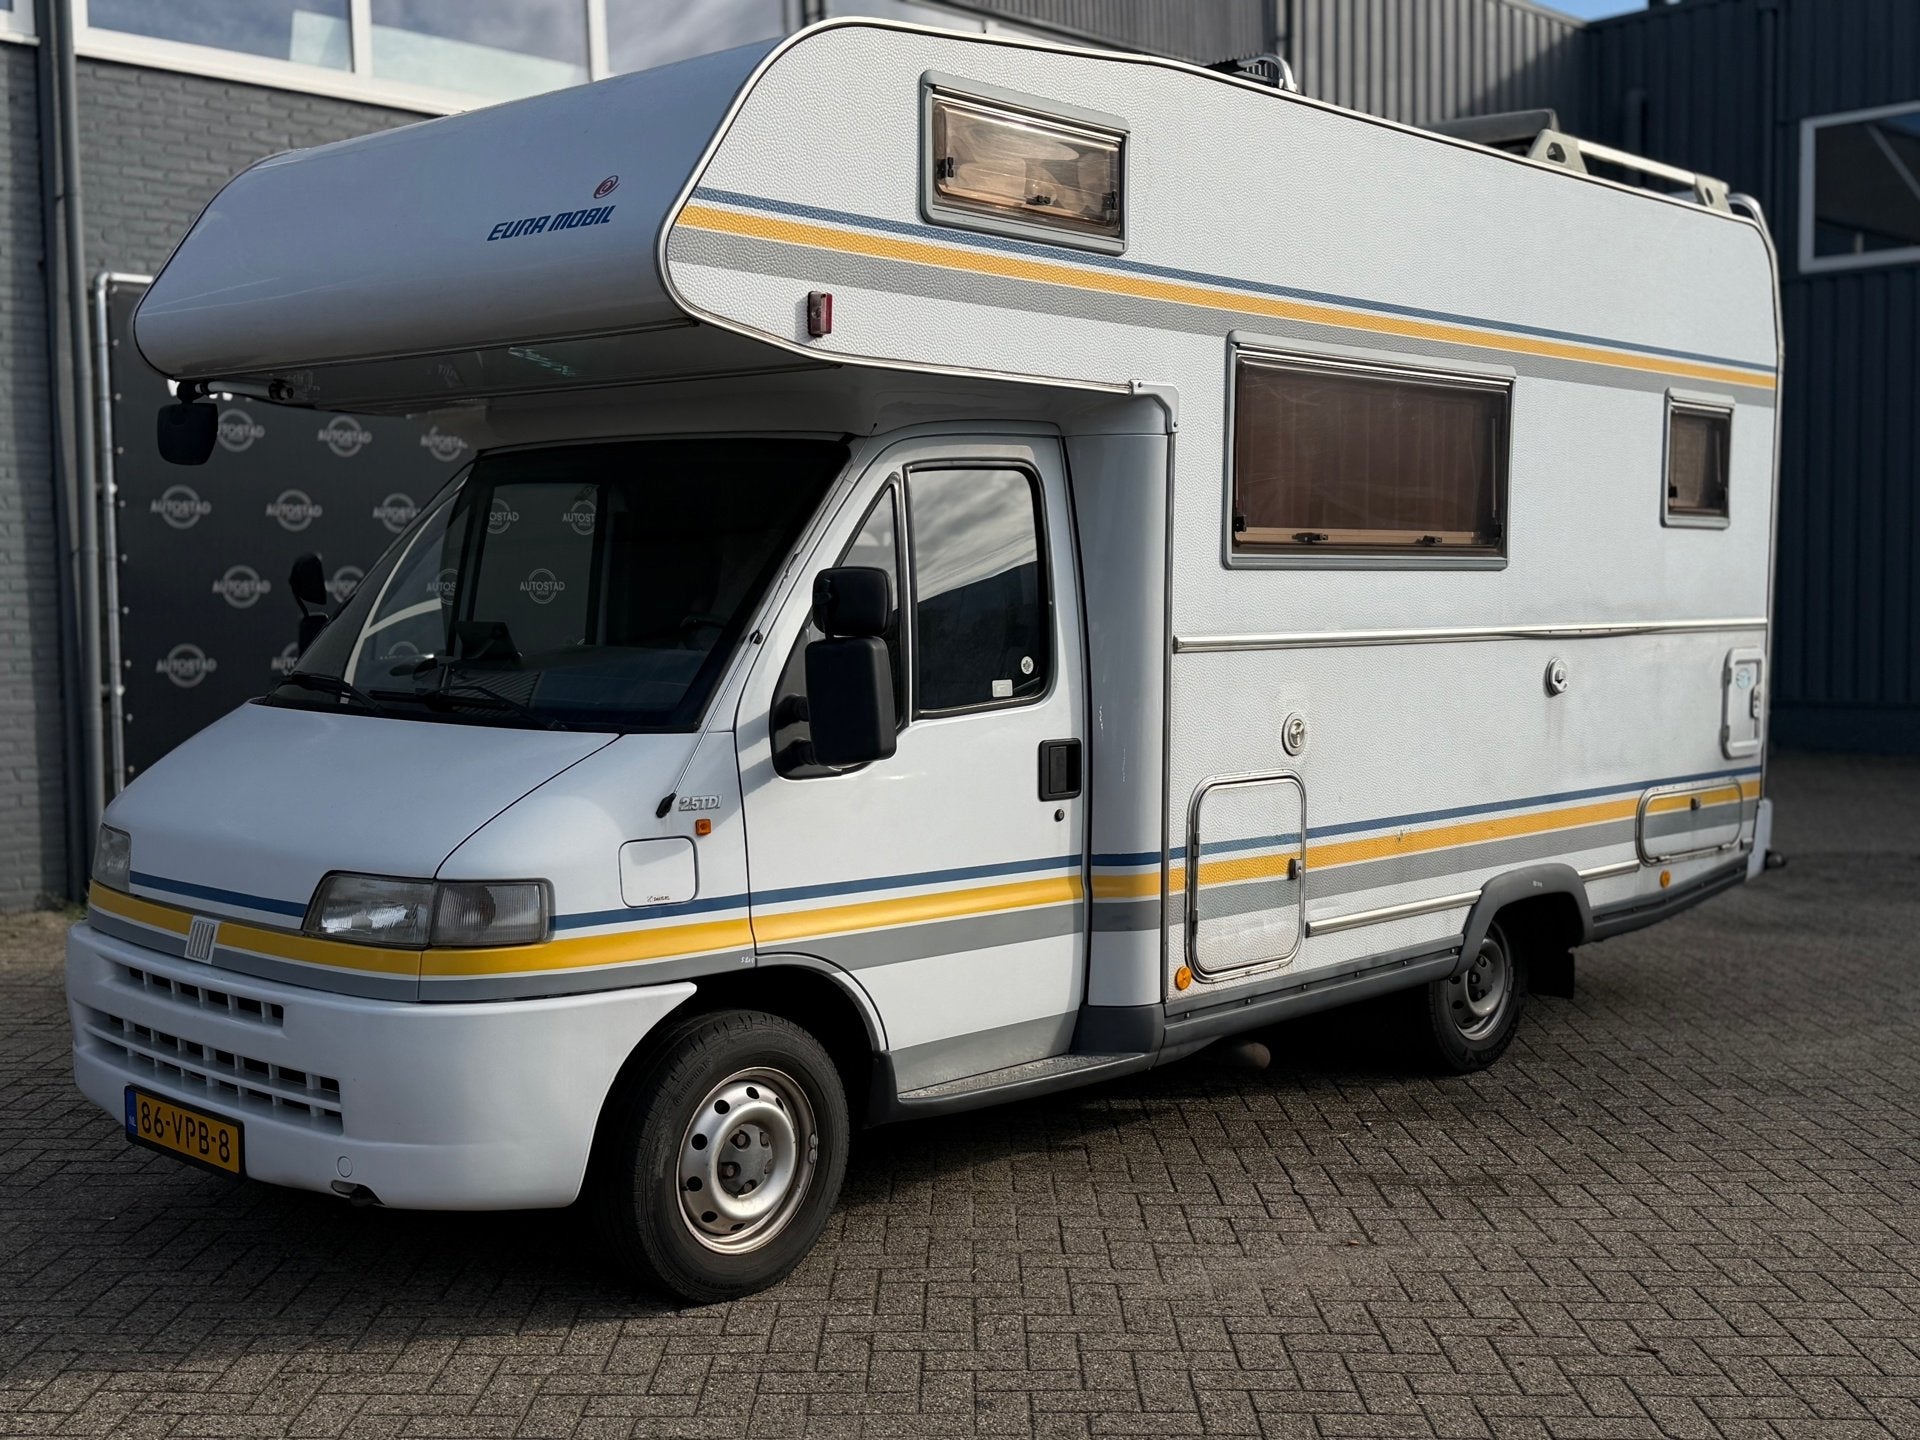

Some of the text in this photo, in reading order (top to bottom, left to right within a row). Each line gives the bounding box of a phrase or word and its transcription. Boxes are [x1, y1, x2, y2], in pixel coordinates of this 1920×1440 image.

[487, 205, 616, 241] EURA MOBIL
[317, 429, 372, 444] AUTOSTAD
[420, 435, 468, 449] AUTOSTA
[150, 499, 212, 515] AUTOSTAD
[265, 504, 323, 519] AUTOSTAD
[489, 512, 520, 522] OSTAD
[561, 513, 596, 523] AUTOST
[212, 579, 271, 595] AUTOSTAD
[426, 582, 457, 593] AUTOS
[519, 581, 566, 592] AUTOSTAD
[155, 657, 217, 674] AUTOSTAD
[141, 1101, 230, 1163] 86-VPB-8
